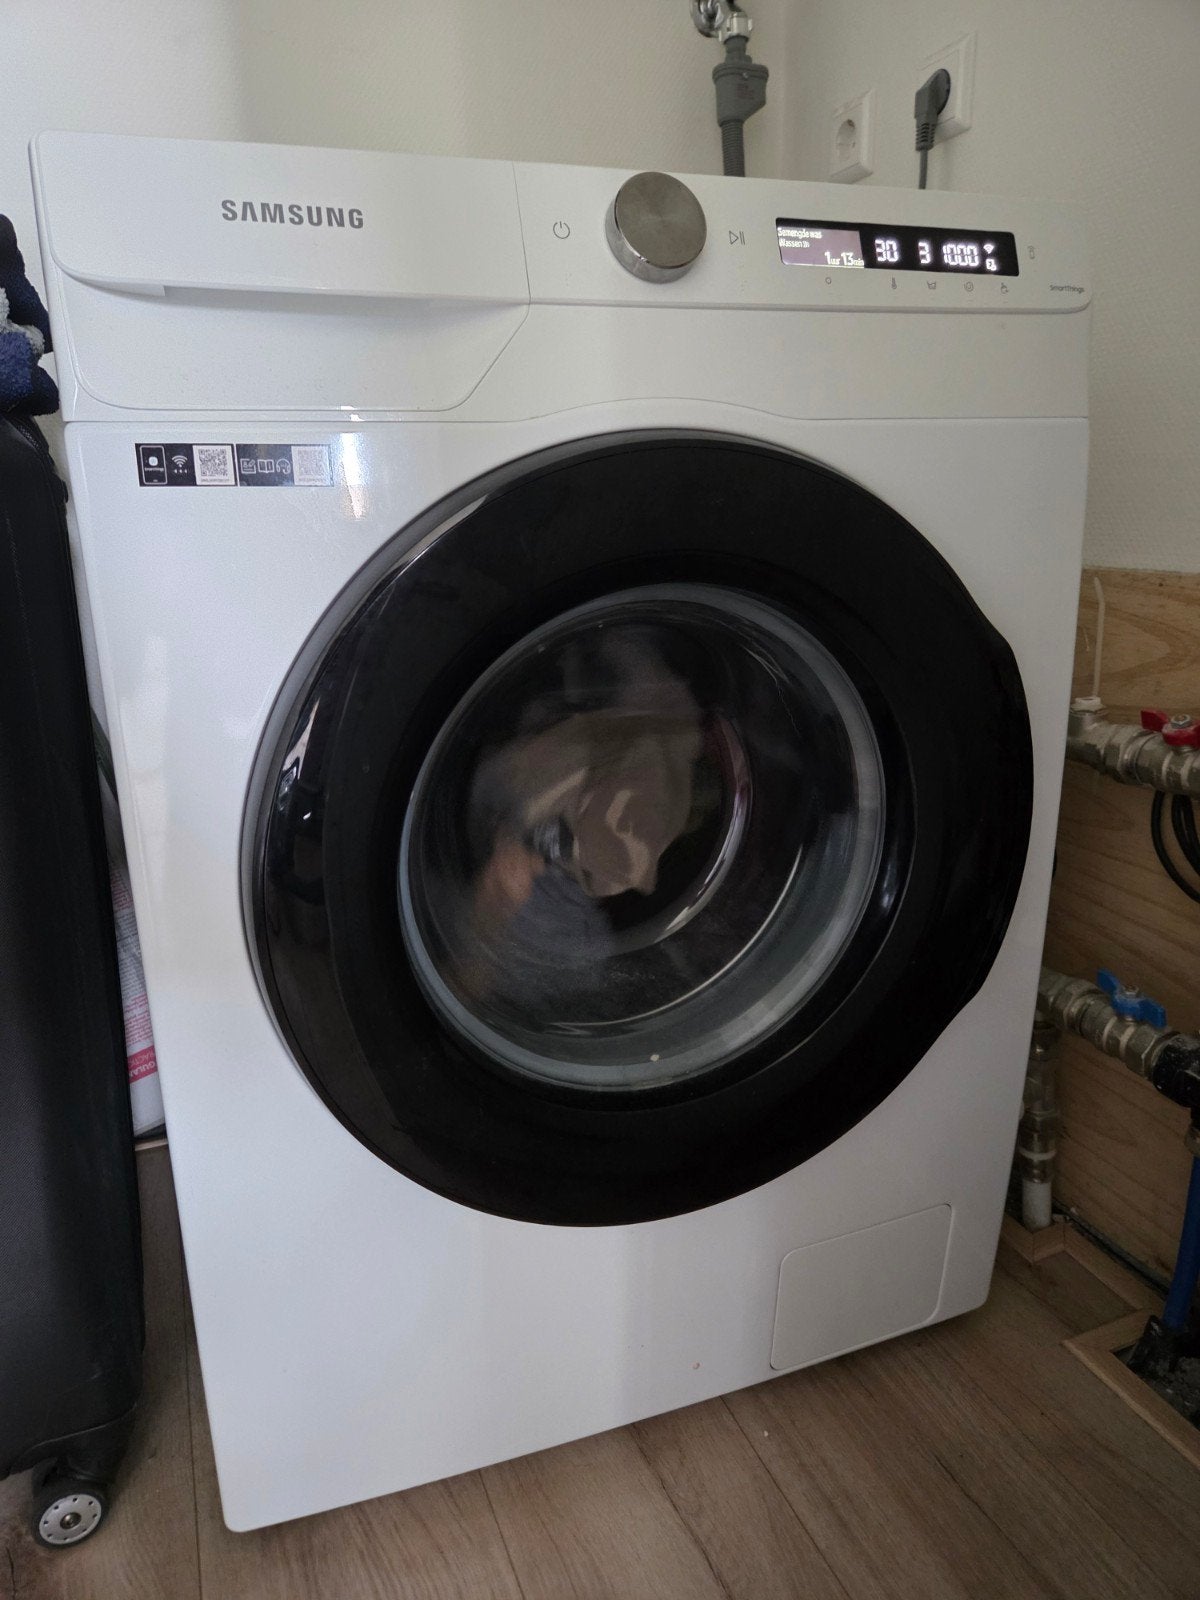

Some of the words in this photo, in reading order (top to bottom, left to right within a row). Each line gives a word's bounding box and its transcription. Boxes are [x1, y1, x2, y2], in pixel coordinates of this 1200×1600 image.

[221, 199, 364, 229] SAMSUNG
[874, 239, 900, 262] 30
[917, 241, 931, 264] 3
[942, 243, 979, 266] 1000
